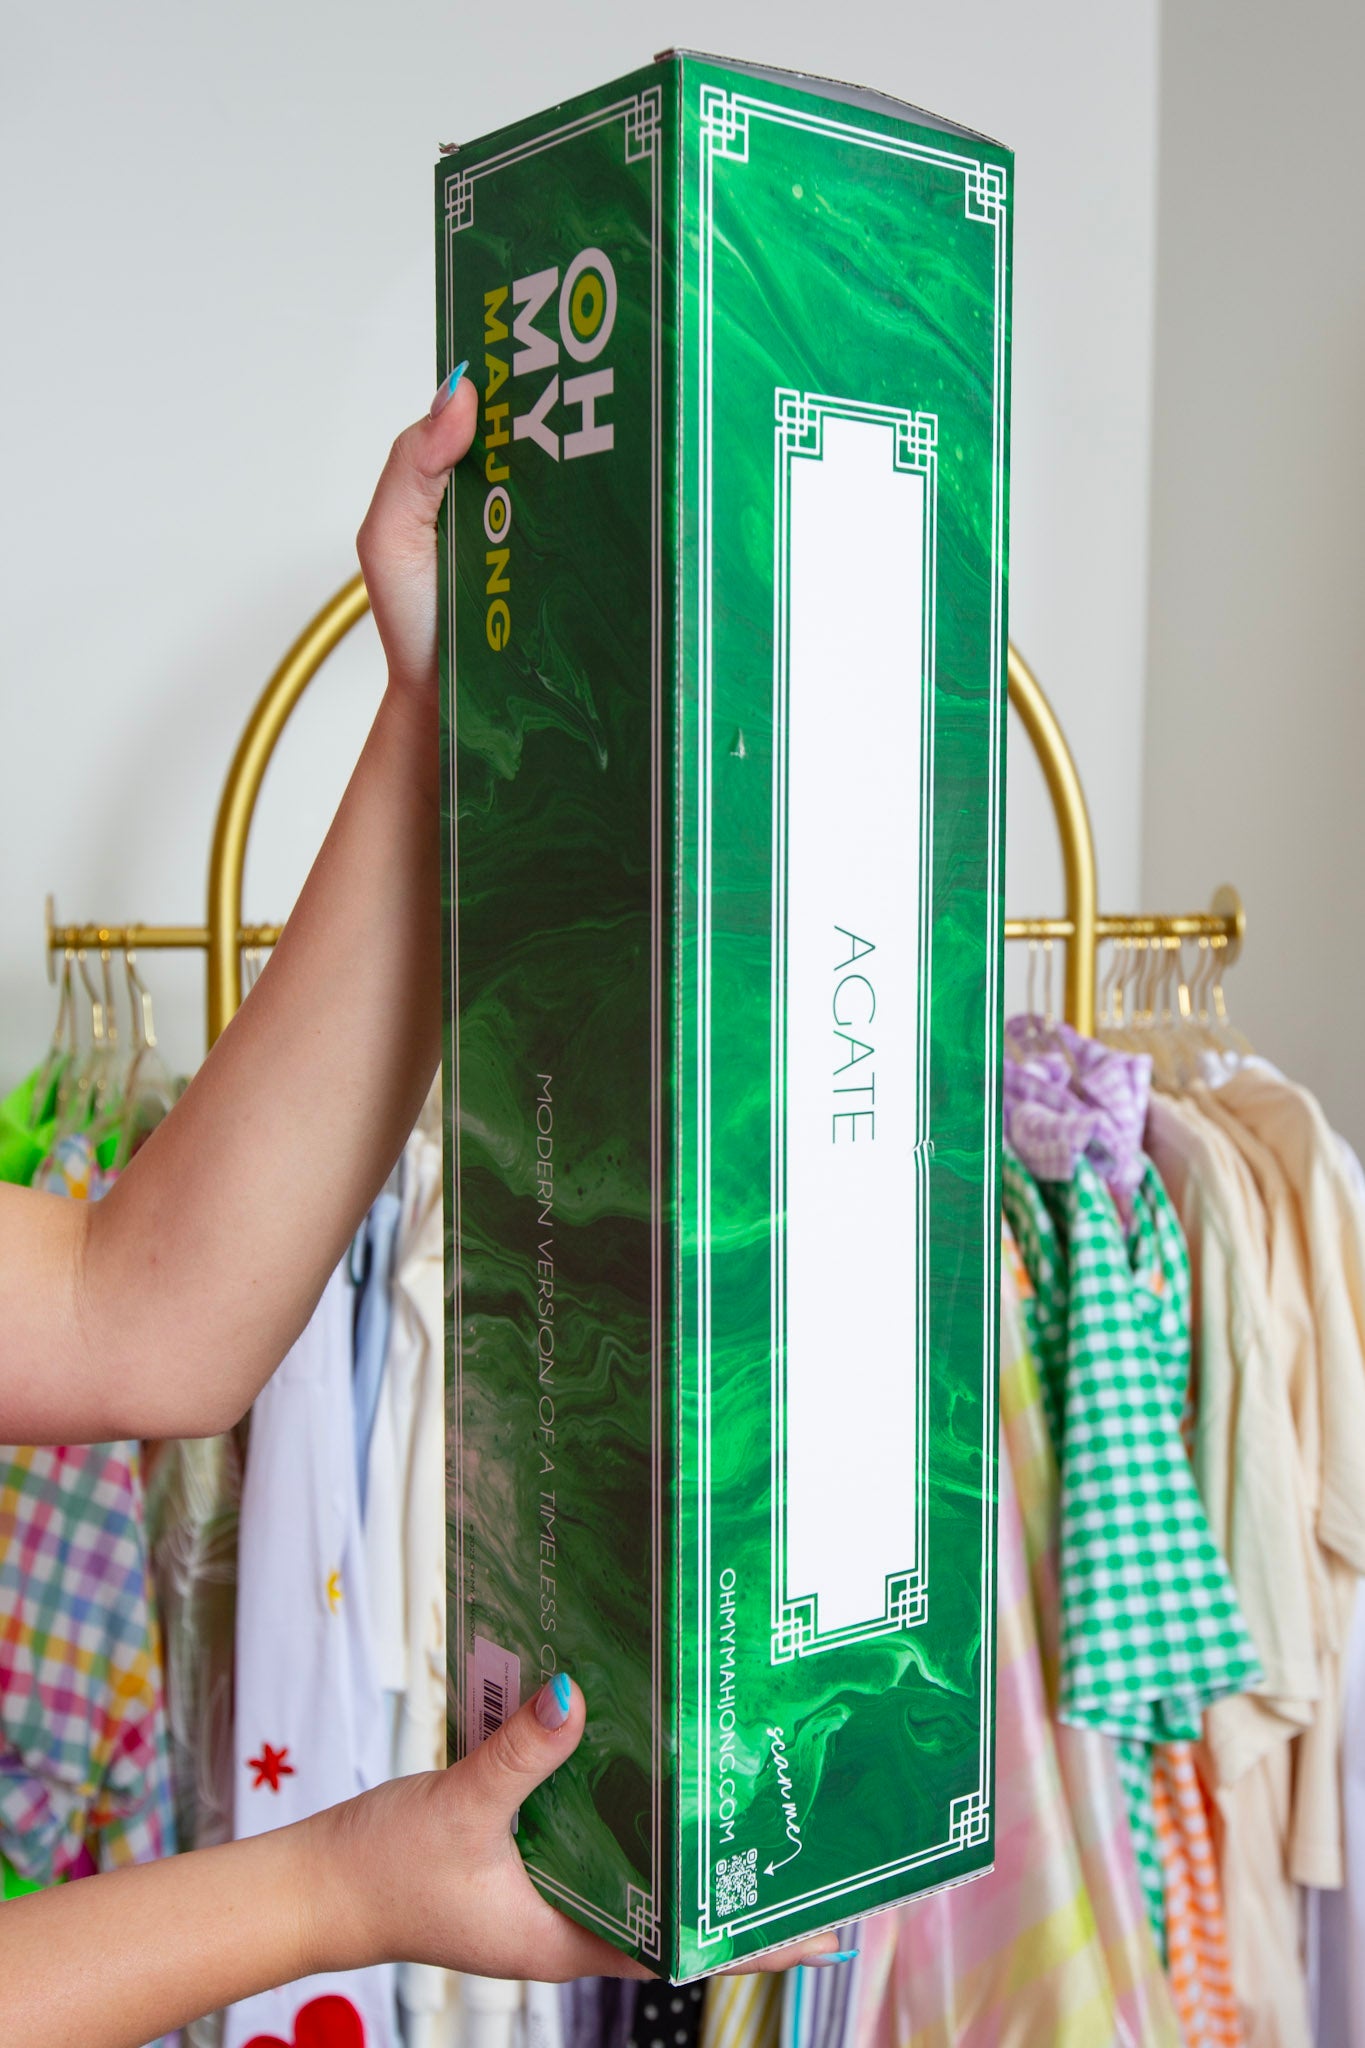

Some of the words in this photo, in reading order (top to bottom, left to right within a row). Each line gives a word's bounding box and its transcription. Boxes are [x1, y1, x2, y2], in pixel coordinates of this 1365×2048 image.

[512, 266, 560, 463] MY
[557, 247, 617, 461] OH
[483, 286, 512, 652] MAHJONG
[833, 925, 876, 1144] AGATE
[536, 1073, 553, 1227] MODERN
[537, 1239, 555, 1383] VERSION
[539, 1395, 555, 1446] OF
[539, 1451, 555, 1475] A
[539, 1490, 556, 1632] TIMELESS
[540, 1644, 557, 1688] CL
[717, 1567, 737, 1844] OHMYMAHJONG.COM
[766, 1726, 792, 1800] scan
[780, 1802, 802, 1842] me
